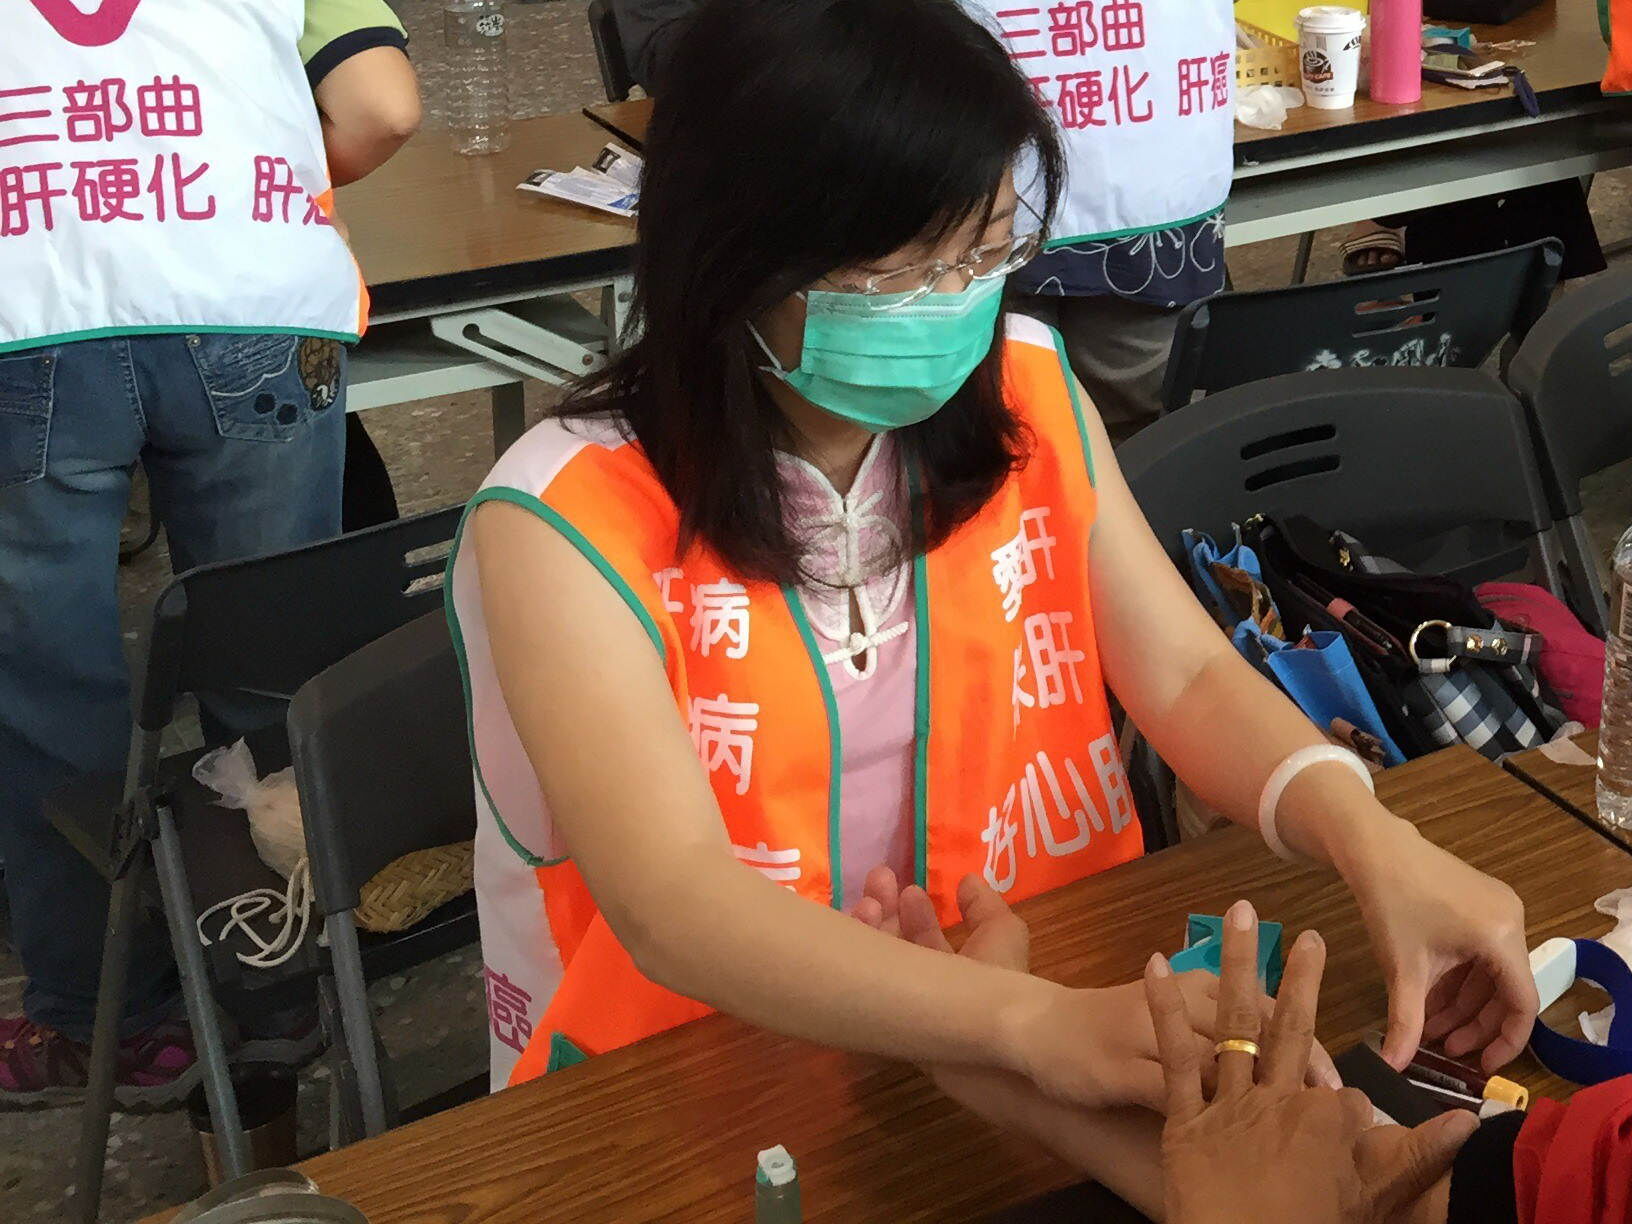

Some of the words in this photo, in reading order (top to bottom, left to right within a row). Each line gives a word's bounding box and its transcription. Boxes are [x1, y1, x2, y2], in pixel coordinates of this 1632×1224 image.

[0, 74, 204, 147] 三部曲
[0, 151, 217, 237] 肝硬化
